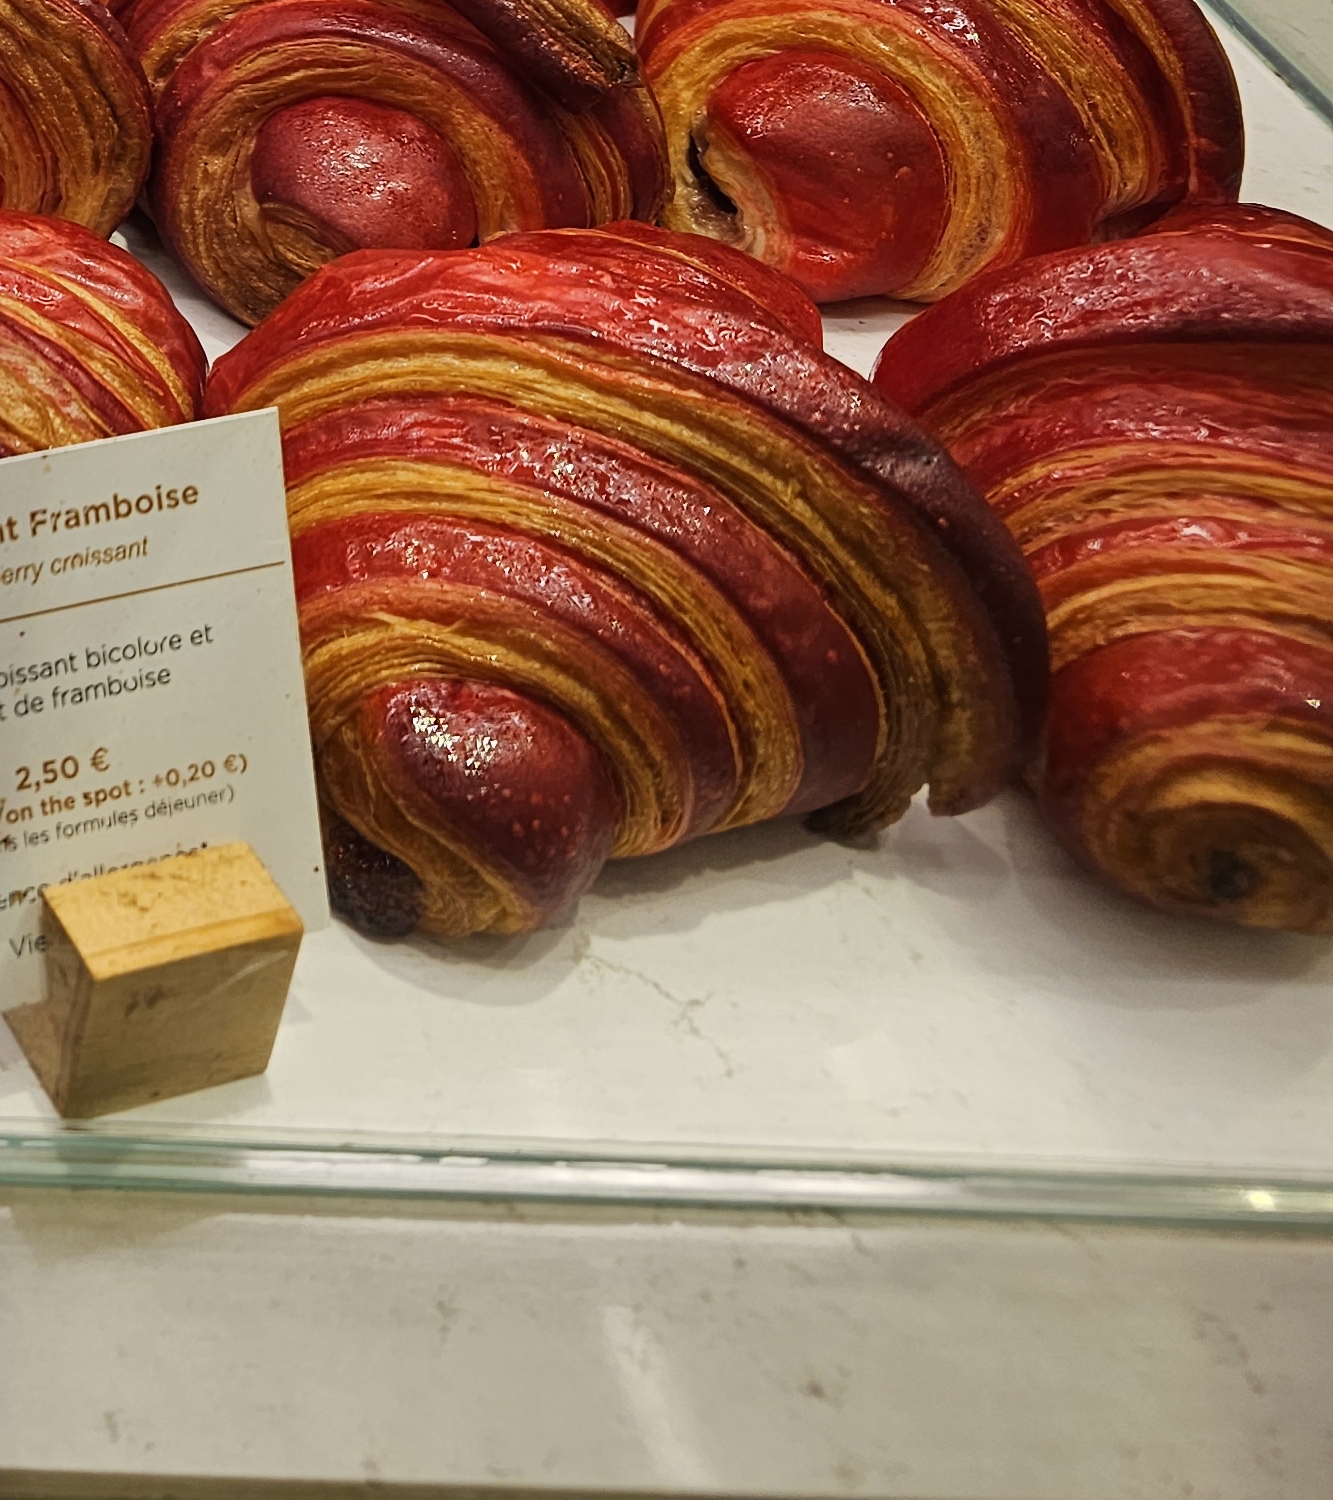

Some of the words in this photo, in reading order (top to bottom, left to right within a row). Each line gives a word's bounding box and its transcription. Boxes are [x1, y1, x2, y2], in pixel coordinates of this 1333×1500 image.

[29, 482, 200, 538] Framboise
[49, 535, 150, 577] croissant
[84, 631, 183, 670] bicolore
[188, 622, 215, 646] et
[12, 692, 46, 718] de
[51, 665, 173, 711] framboise
[14, 754, 81, 794] 2,50
[89, 746, 111, 774] €
[39, 792, 77, 818] the
[82, 778, 133, 811] spot
[137, 779, 145, 795] :
[151, 758, 217, 791] +0,20
[222, 752, 249, 778] €)
[23, 828, 51, 850] les
[55, 808, 140, 843] formules
[143, 783, 236, 822] déjeuner)
